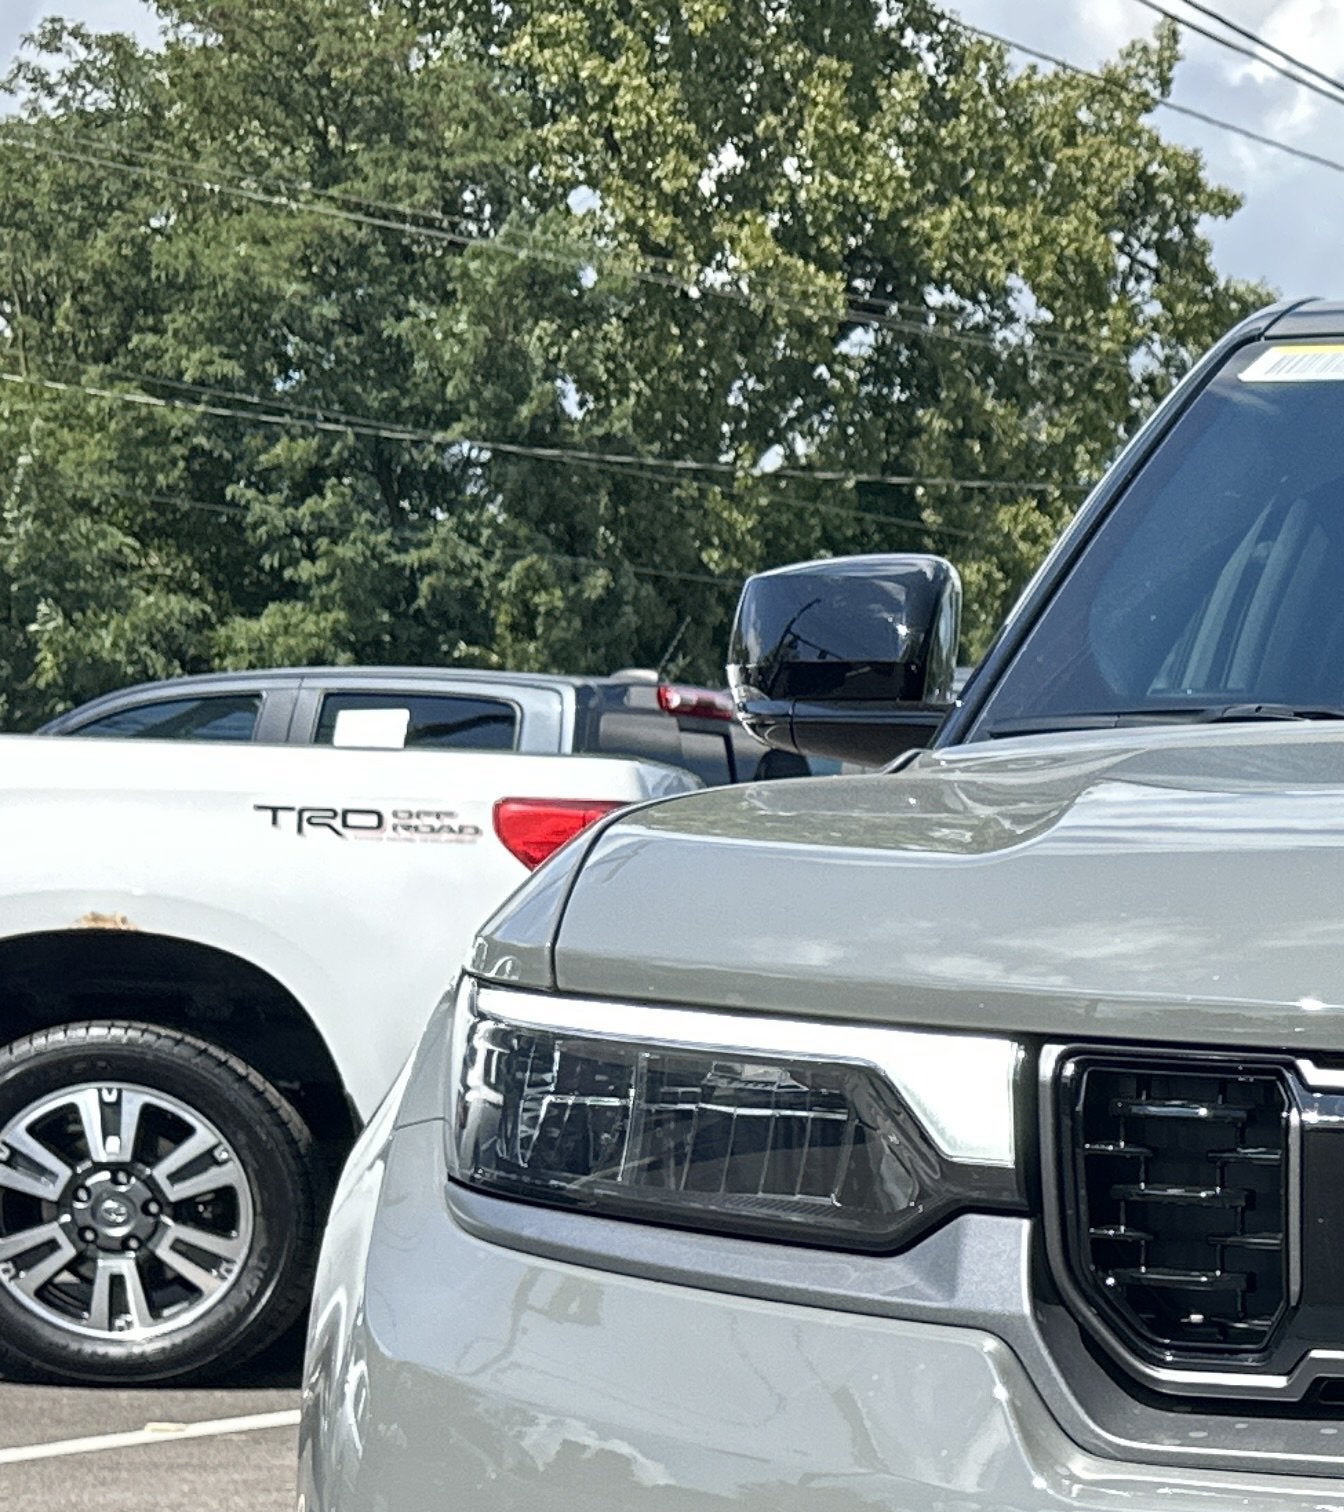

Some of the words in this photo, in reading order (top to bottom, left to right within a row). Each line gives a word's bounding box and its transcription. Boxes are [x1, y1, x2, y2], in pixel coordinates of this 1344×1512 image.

[253, 803, 386, 839] TRD
[391, 809, 458, 821] OFF
[391, 823, 483, 837] ROAD
